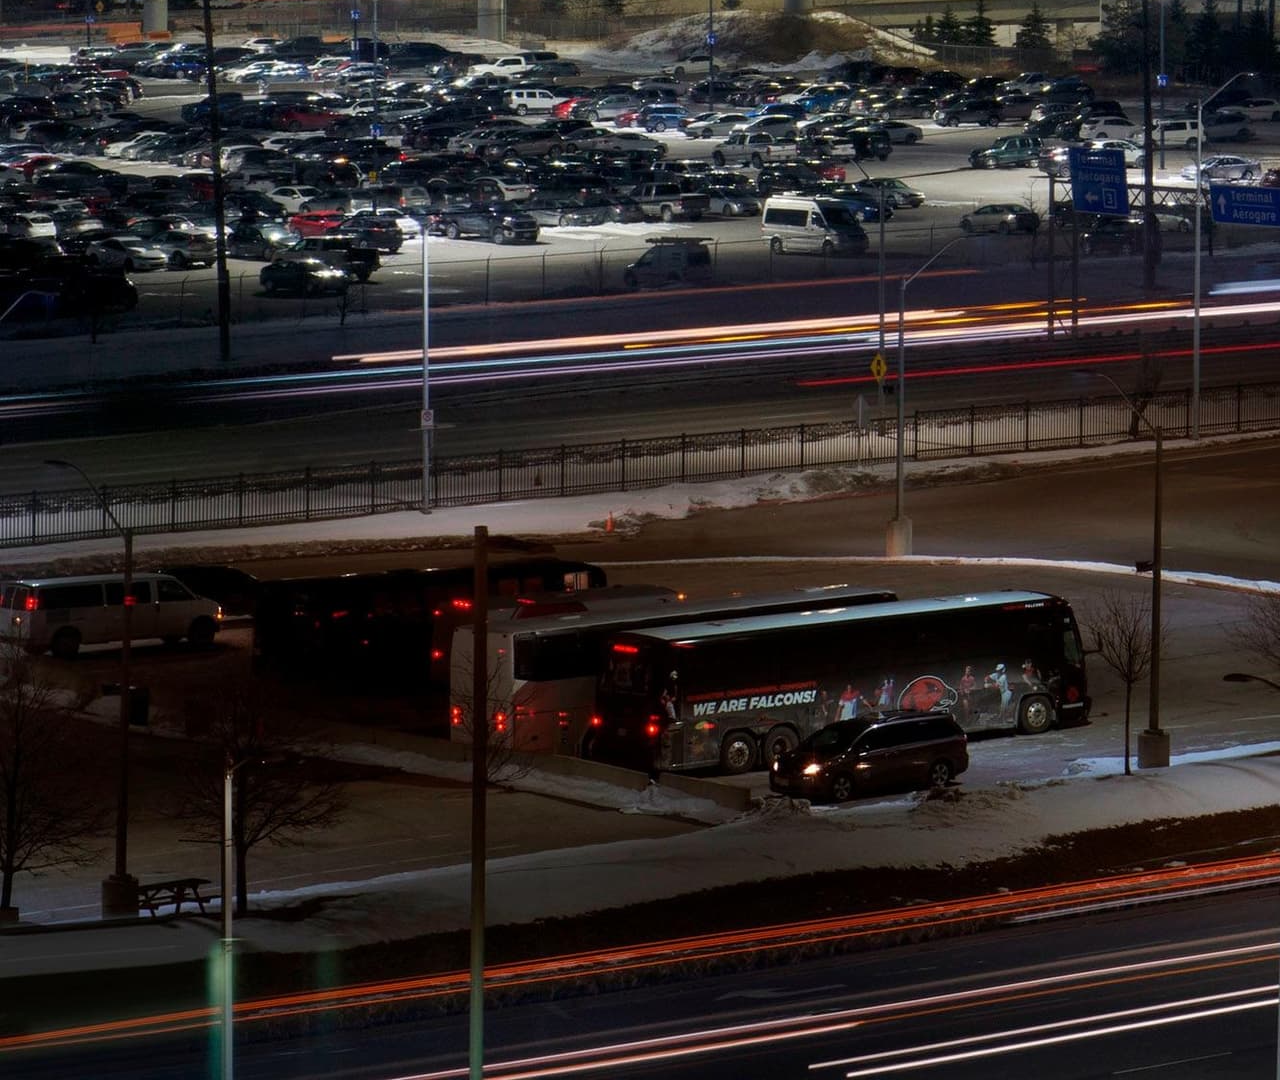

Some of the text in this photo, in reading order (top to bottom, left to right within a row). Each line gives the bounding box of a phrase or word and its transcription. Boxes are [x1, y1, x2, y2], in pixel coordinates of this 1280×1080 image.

[1231, 190, 1273, 203] Terminal
[1232, 208, 1277, 223] Aérogare
[692, 701, 717, 718] WE
[717, 697, 749, 713] ARE
[748, 689, 818, 710] FALCONS!
